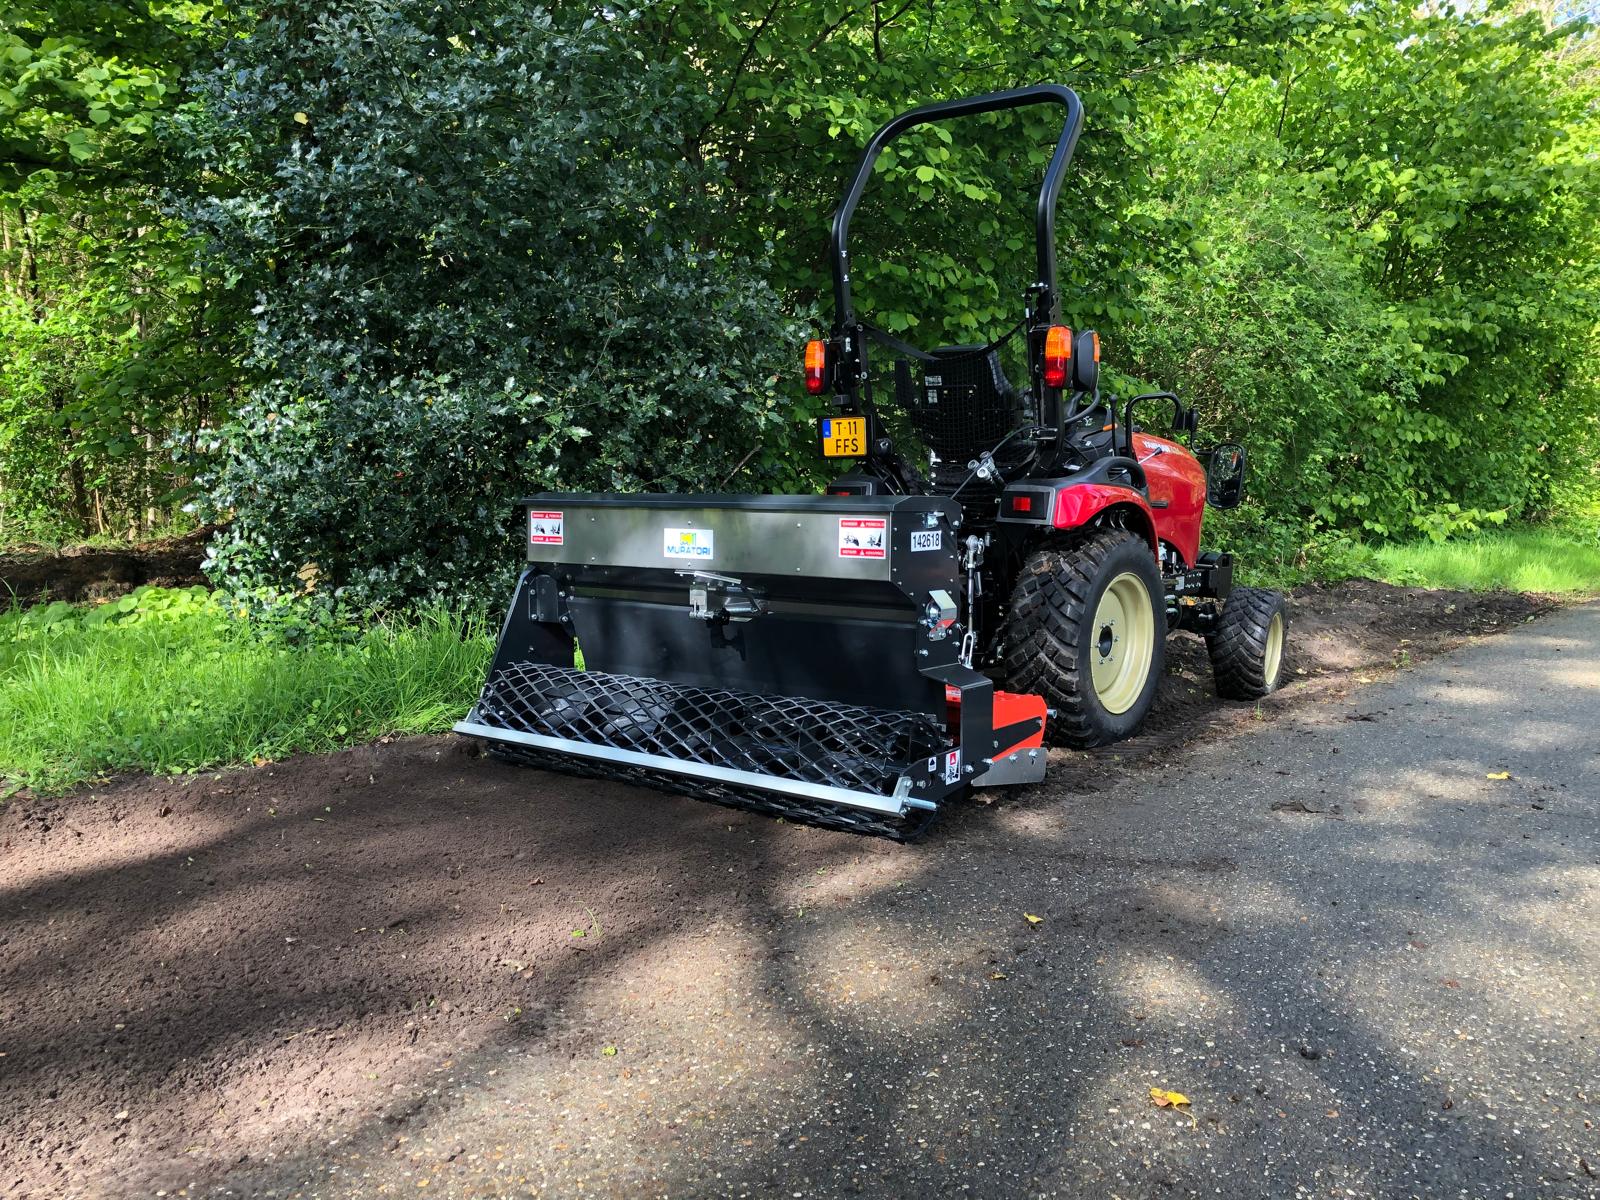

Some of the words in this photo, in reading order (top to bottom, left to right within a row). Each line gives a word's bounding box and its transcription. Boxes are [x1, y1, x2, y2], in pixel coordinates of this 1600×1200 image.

[835, 438, 859, 453] FFS
[912, 532, 940, 548] 142618
[667, 545, 711, 556] MURATORI
